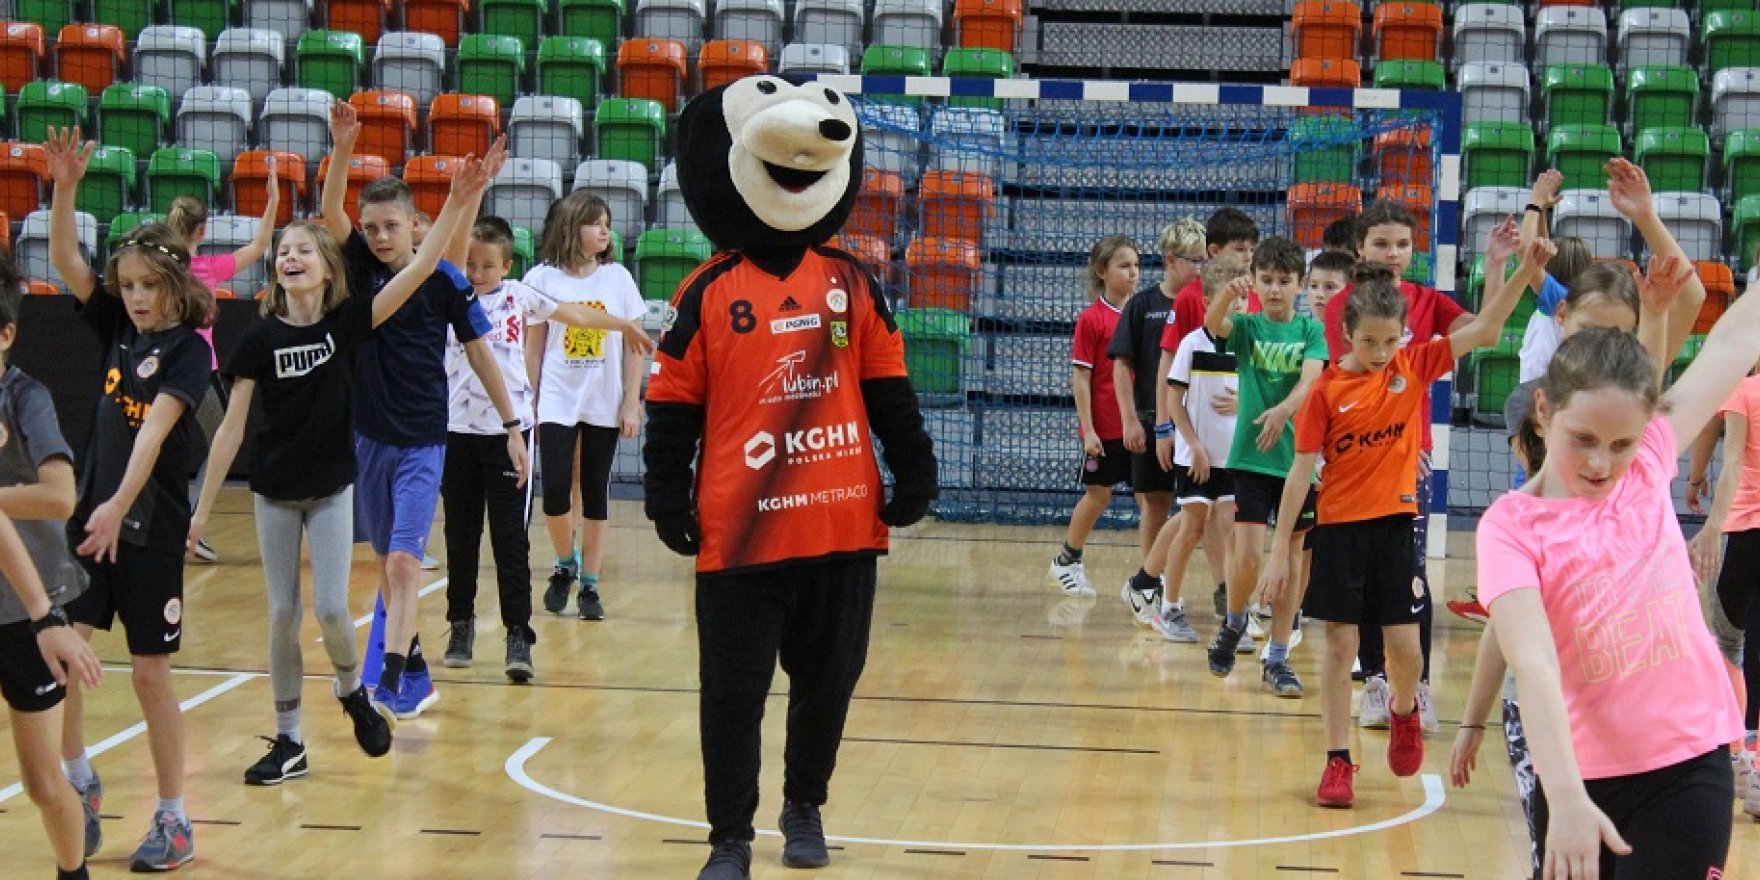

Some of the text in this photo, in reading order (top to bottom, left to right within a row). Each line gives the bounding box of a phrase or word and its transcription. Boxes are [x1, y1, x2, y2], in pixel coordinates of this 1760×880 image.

[730, 300, 757, 334] 8
[1252, 340, 1306, 372] NIKE
[1575, 591, 1690, 684] BEAT
